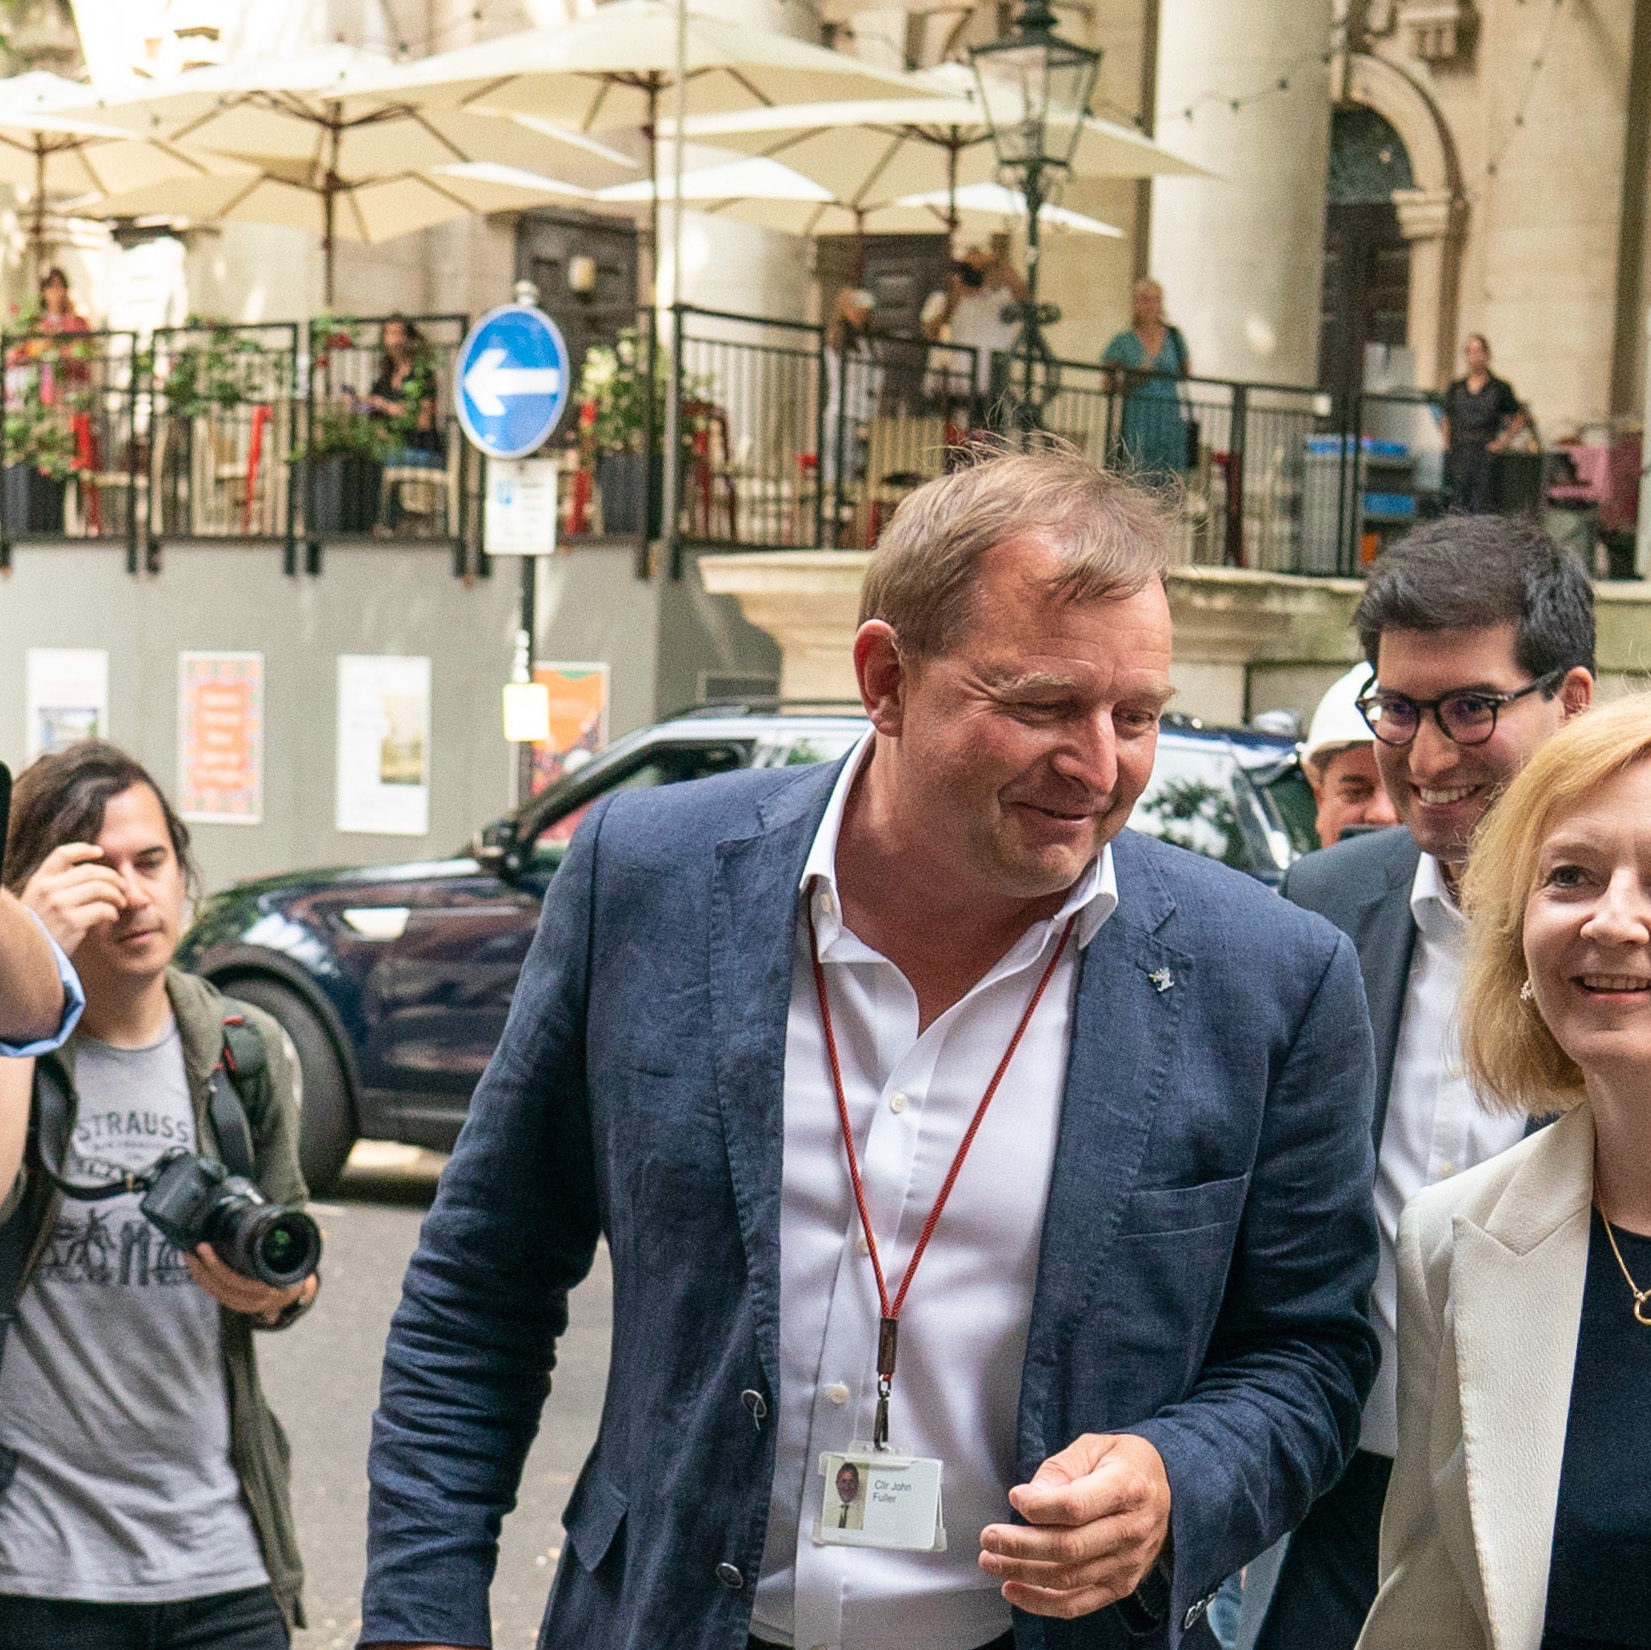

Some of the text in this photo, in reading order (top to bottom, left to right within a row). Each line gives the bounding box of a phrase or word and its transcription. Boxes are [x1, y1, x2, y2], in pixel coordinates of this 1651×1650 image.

[78, 1110, 189, 1143] STRAUSS
[891, 1481, 912, 1492] John
[872, 1491, 897, 1504] Fuller
